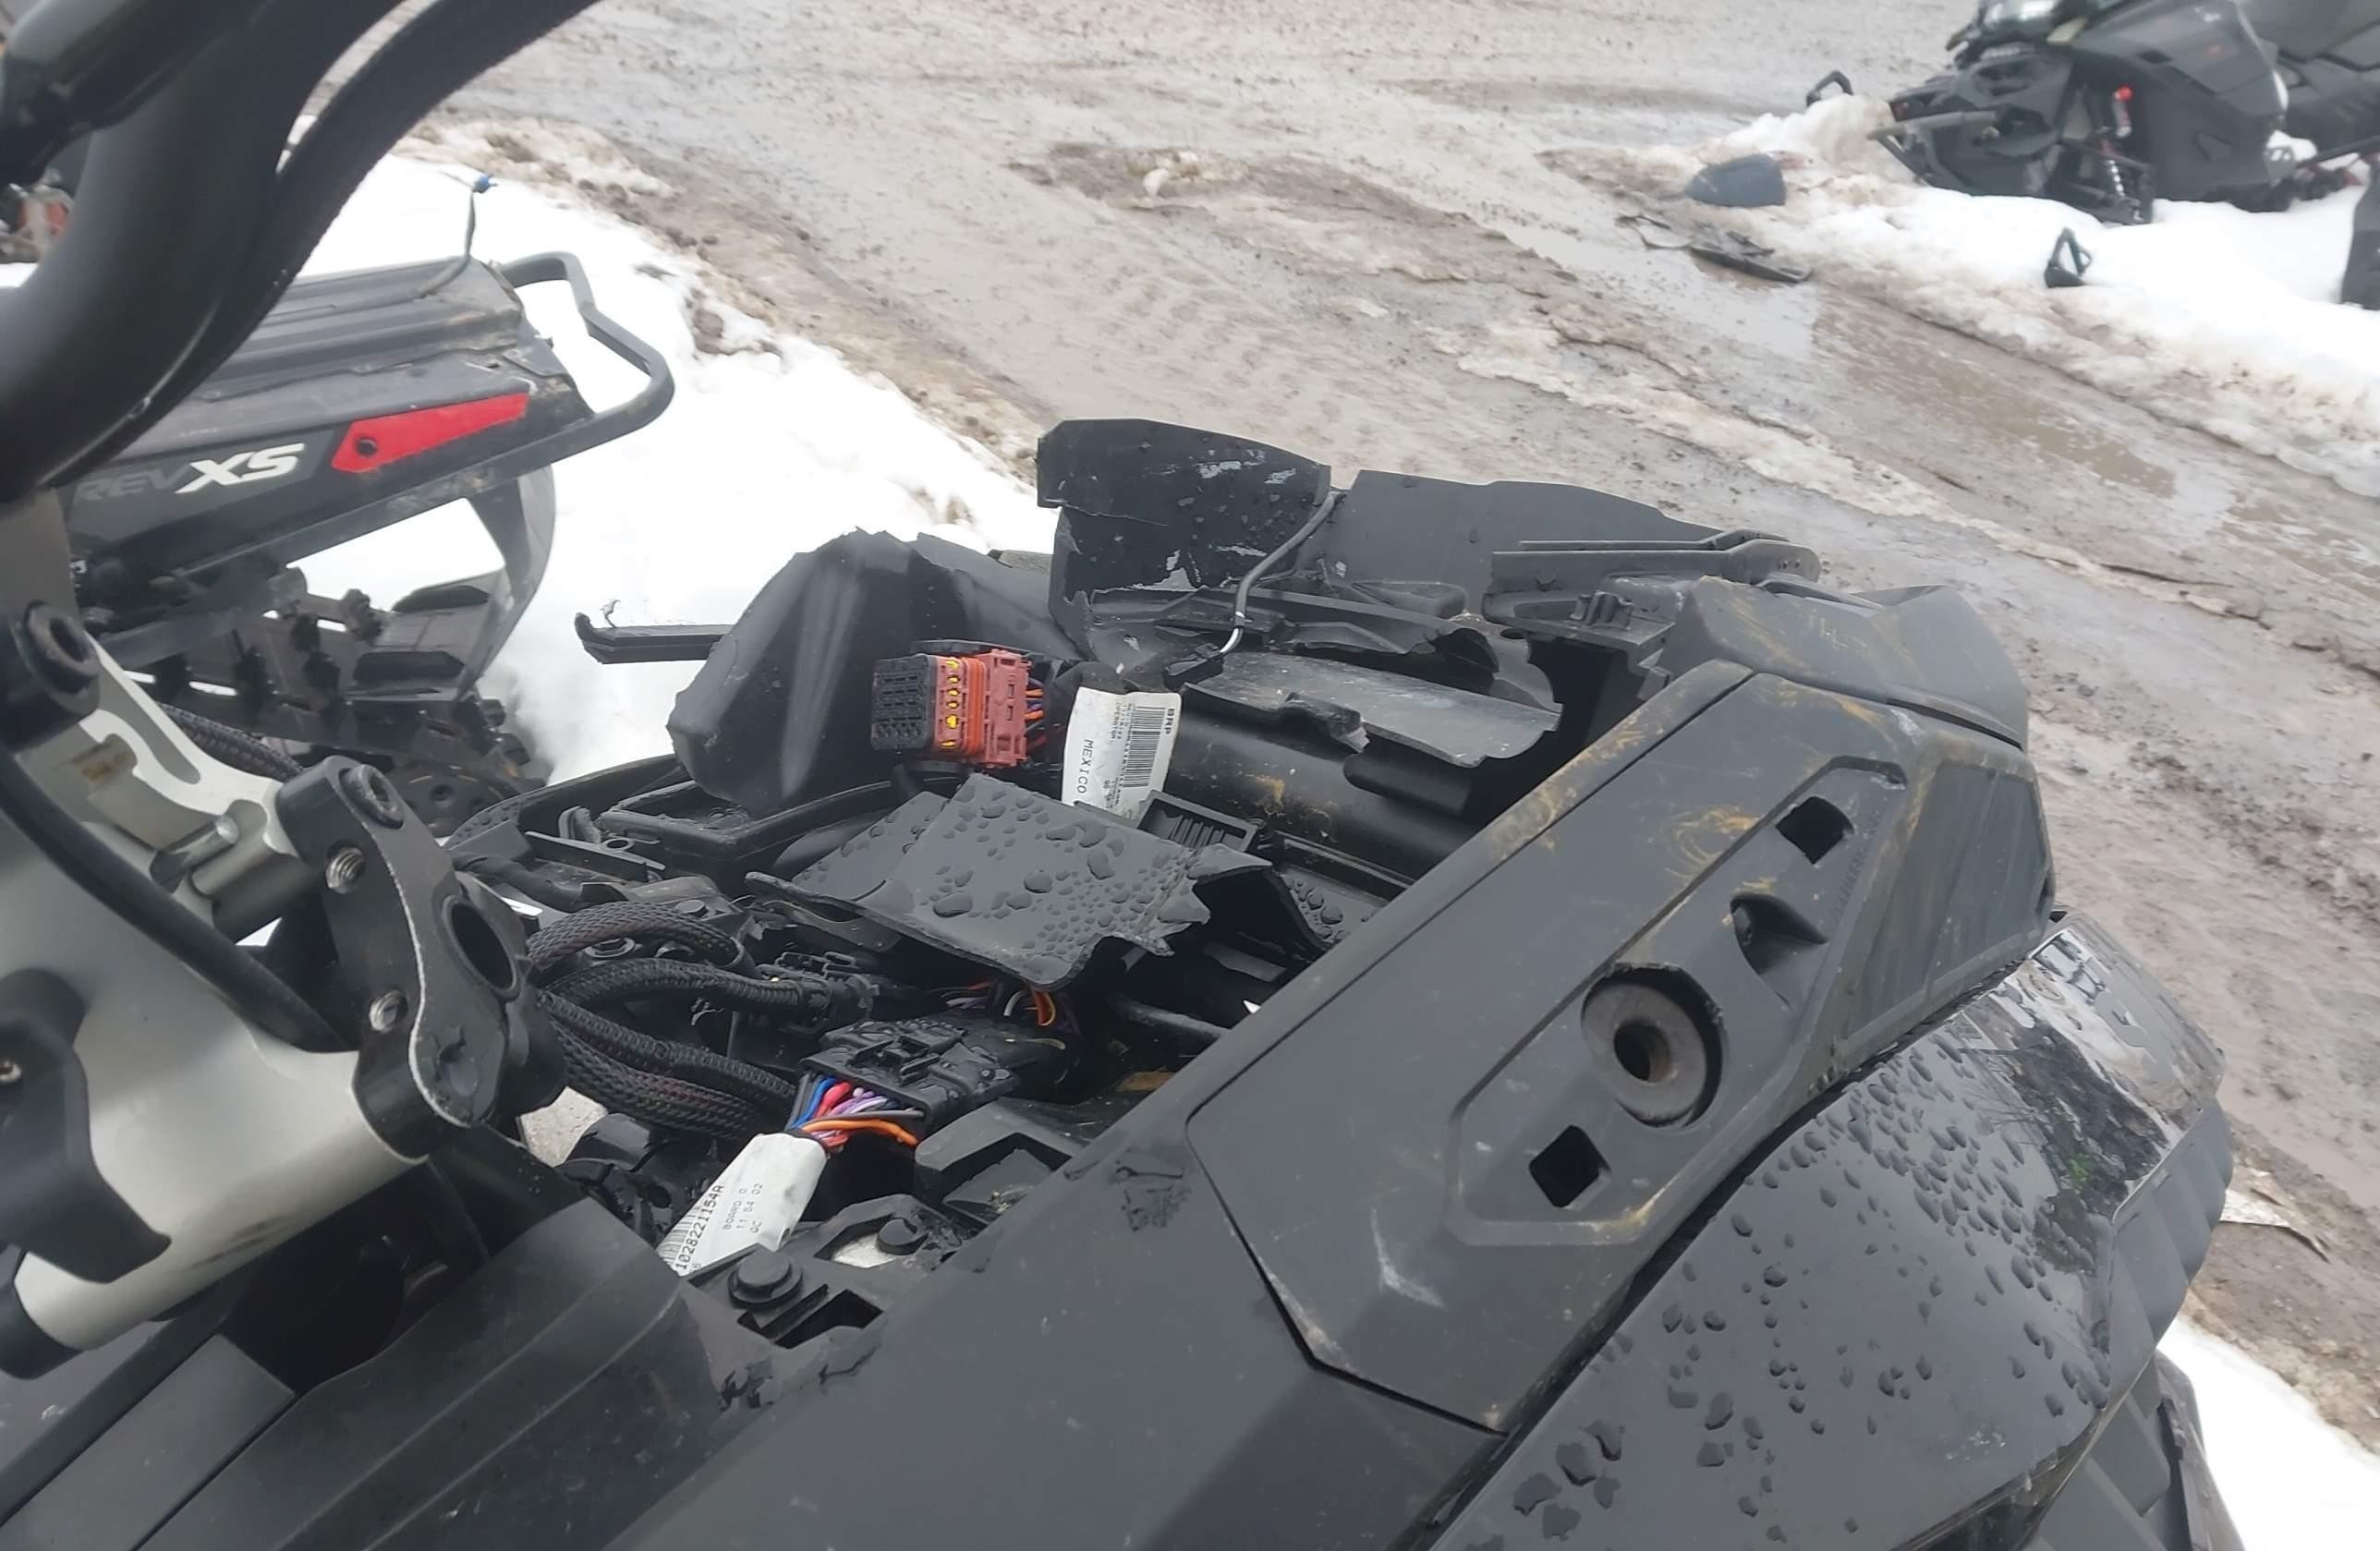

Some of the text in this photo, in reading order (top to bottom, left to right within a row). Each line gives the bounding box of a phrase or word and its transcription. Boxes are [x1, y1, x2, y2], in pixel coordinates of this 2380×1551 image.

[1164, 708, 1175, 734] BRP
[1076, 738, 1094, 794] MEXICO
[675, 1185, 724, 1270] 1028221154A
